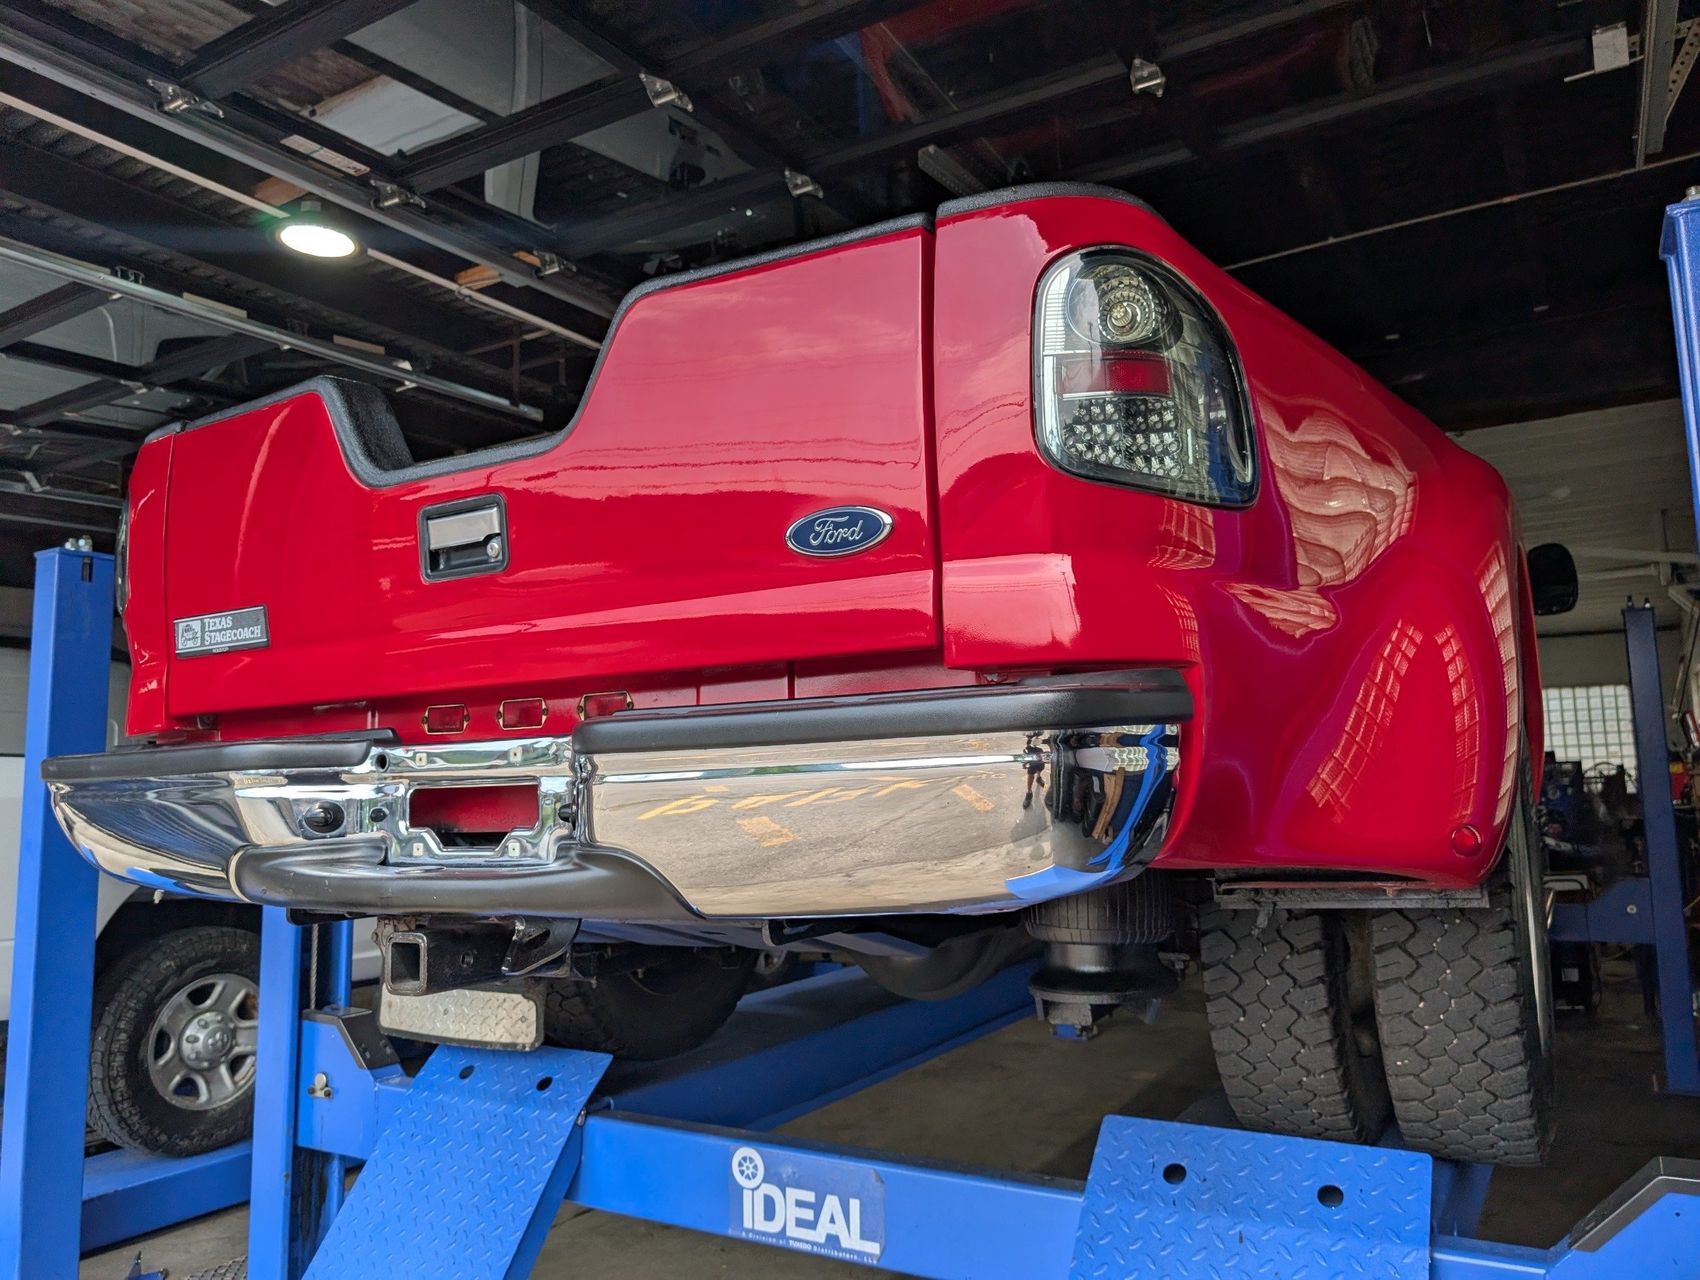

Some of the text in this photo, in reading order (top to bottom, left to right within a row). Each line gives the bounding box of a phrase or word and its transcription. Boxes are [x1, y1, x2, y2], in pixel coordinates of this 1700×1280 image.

[809, 516, 863, 546] Ford
[204, 616, 233, 631] TEXAS
[204, 625, 261, 646] STAGECOACH
